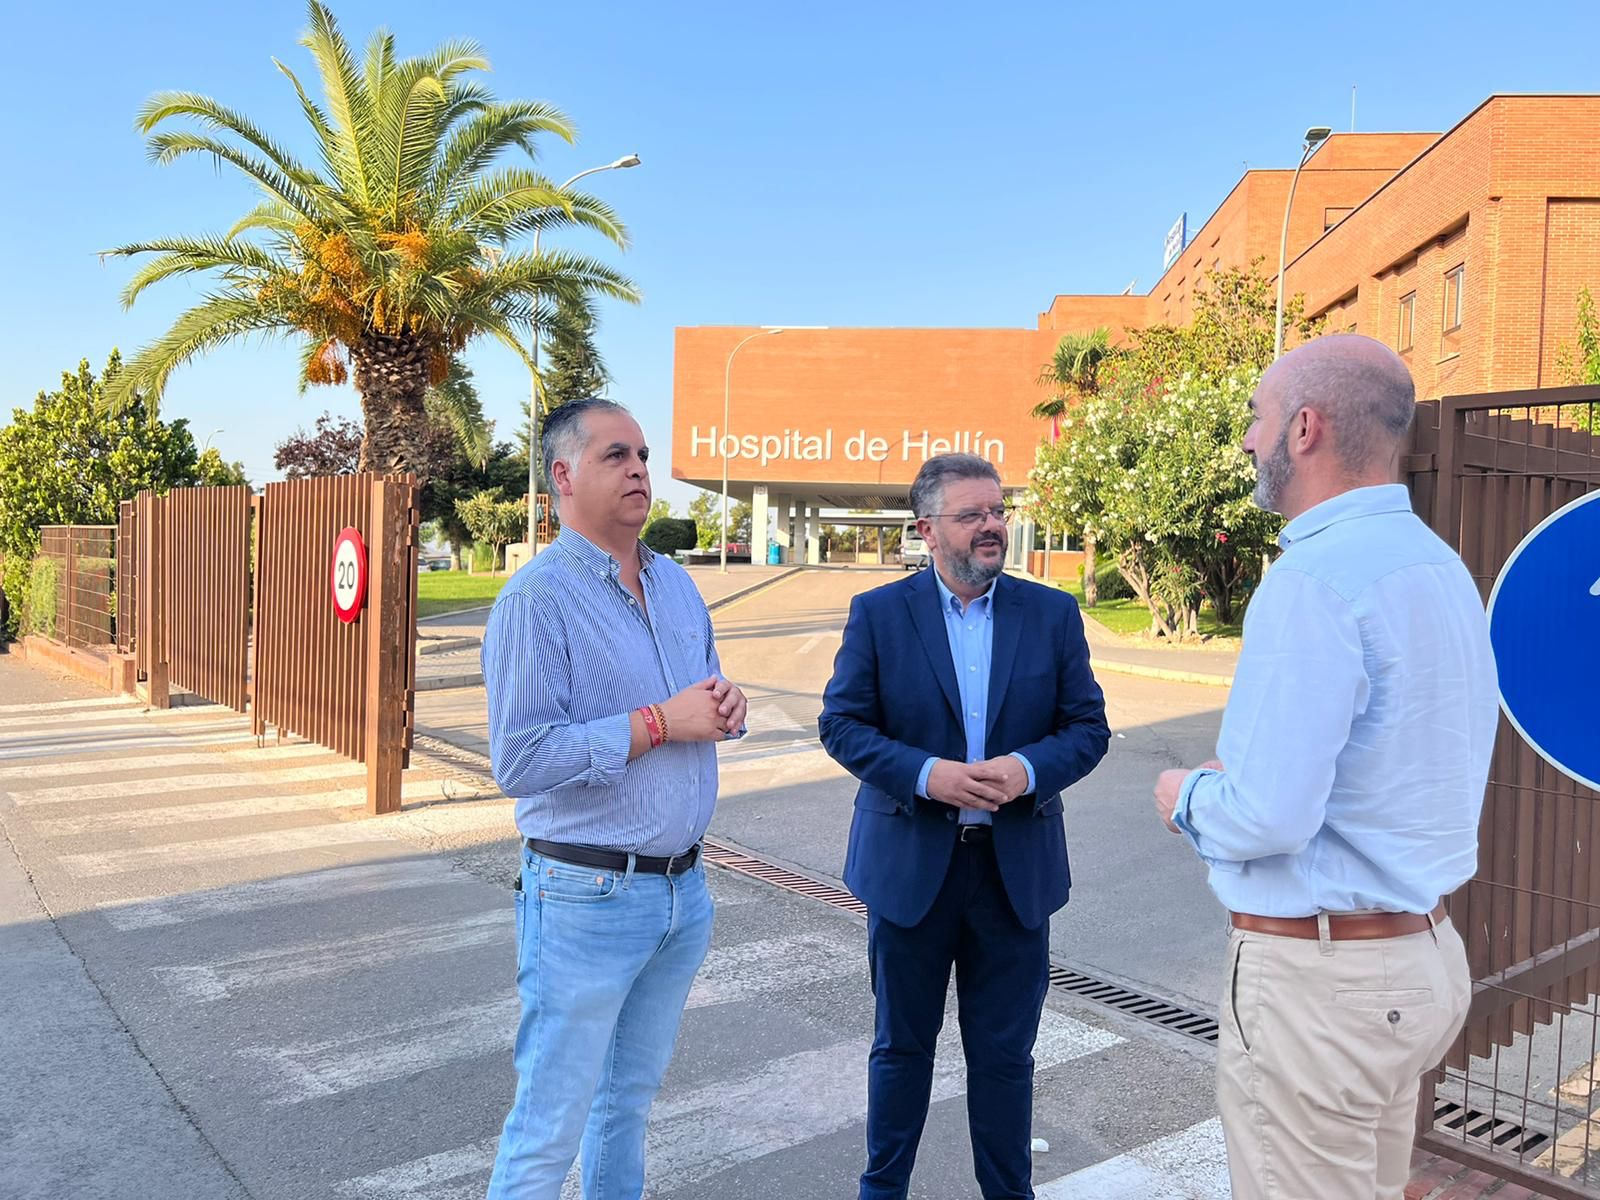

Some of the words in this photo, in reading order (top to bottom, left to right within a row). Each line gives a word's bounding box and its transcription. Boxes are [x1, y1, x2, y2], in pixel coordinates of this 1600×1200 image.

[691, 425, 832, 467] Hospital
[844, 429, 889, 461] de
[902, 429, 1005, 464] Hellín
[338, 561, 355, 589] 20
